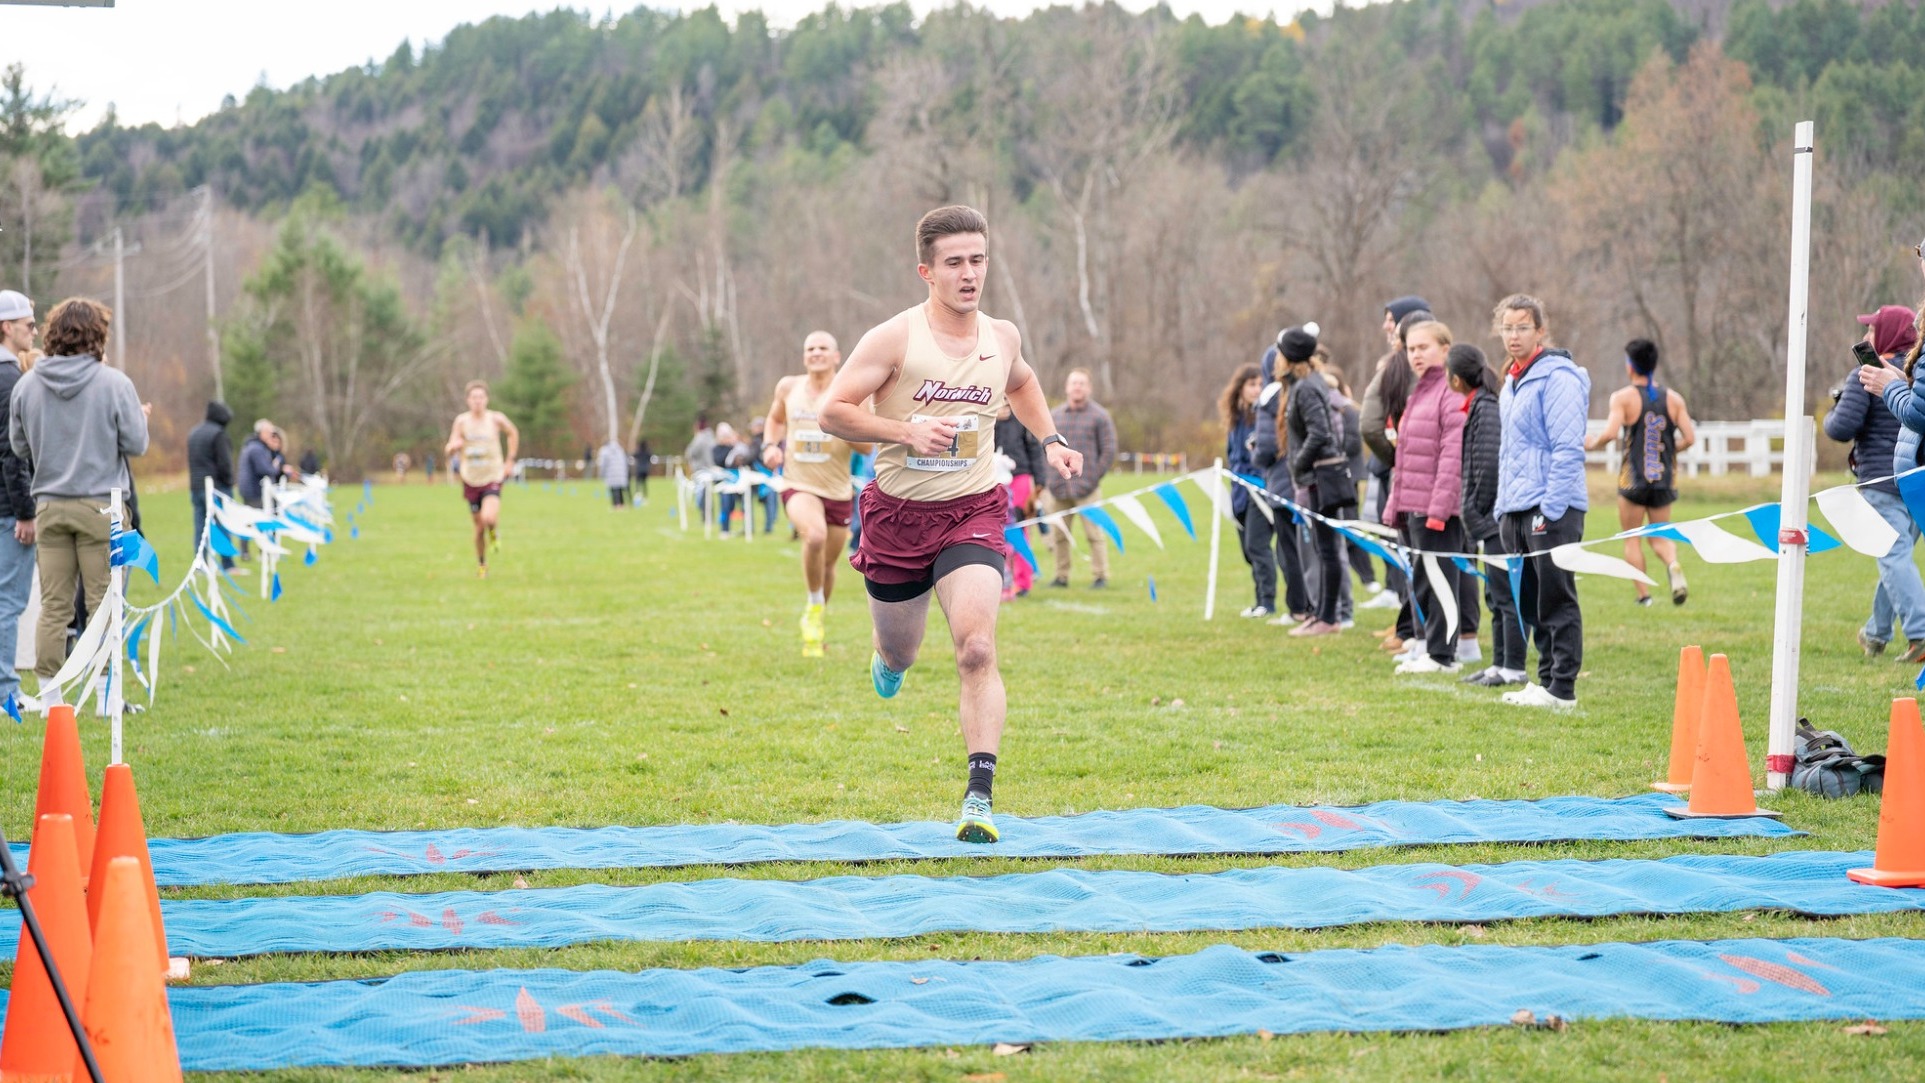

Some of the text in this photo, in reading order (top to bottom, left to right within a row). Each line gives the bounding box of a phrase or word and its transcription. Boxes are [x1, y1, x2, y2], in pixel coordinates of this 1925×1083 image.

[914, 380, 991, 405] Norwich
[1645, 412, 1666, 482] Saints
[917, 459, 968, 467] CHAMPIONSHIPS
